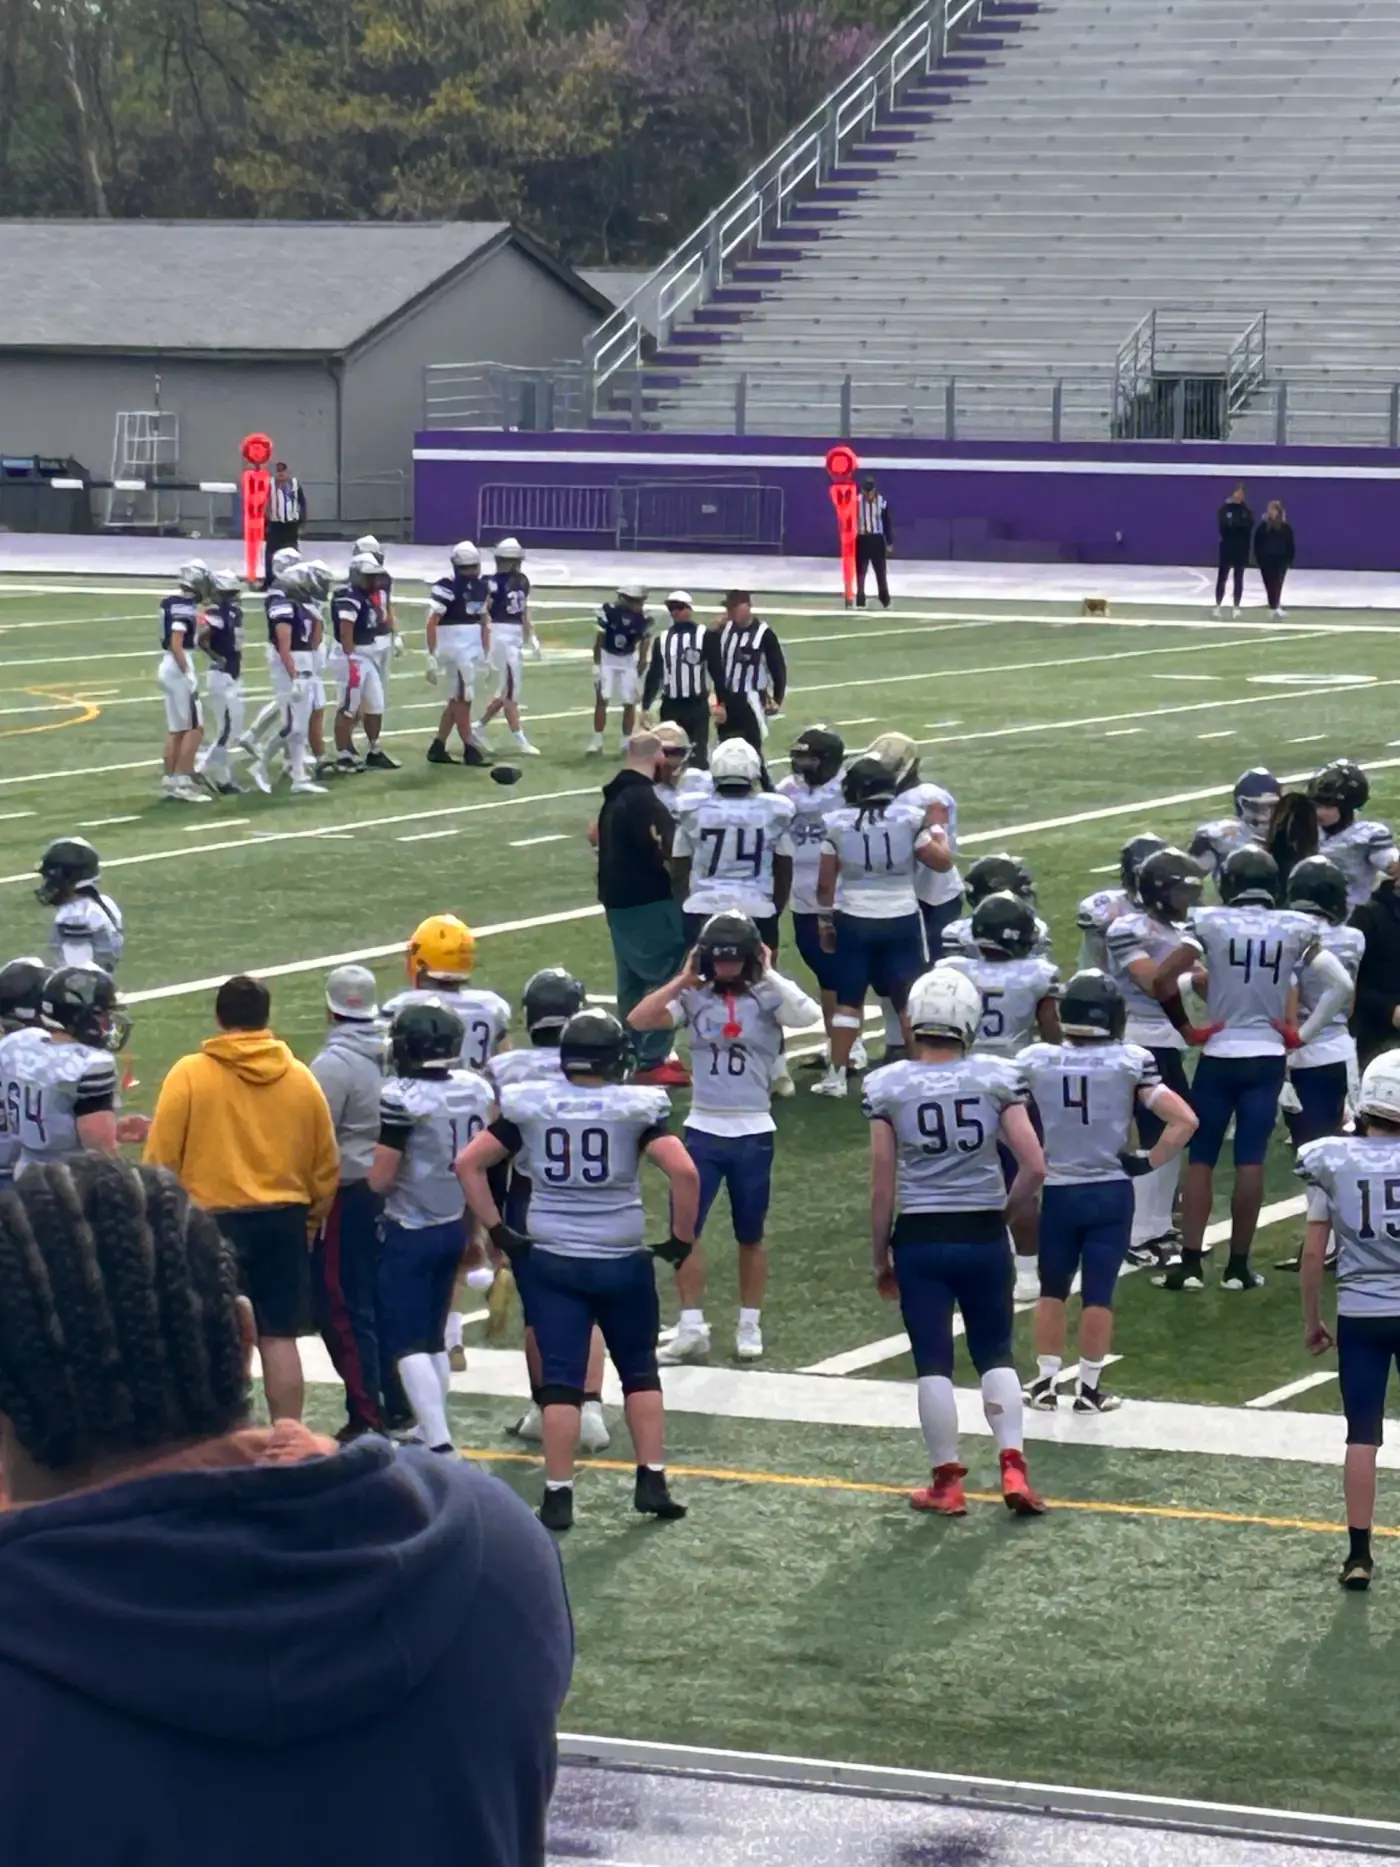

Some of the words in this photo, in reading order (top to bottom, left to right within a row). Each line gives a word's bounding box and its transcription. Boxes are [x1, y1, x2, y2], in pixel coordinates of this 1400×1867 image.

[701, 828, 763, 878] 74
[863, 831, 893, 872] 11
[1229, 938, 1283, 985] 44
[982, 991, 1005, 1038] 5
[709, 1042, 747, 1077] 16
[1063, 1074, 1089, 1125] 4
[917, 1096, 984, 1155] 95
[544, 1126, 611, 1184] 99
